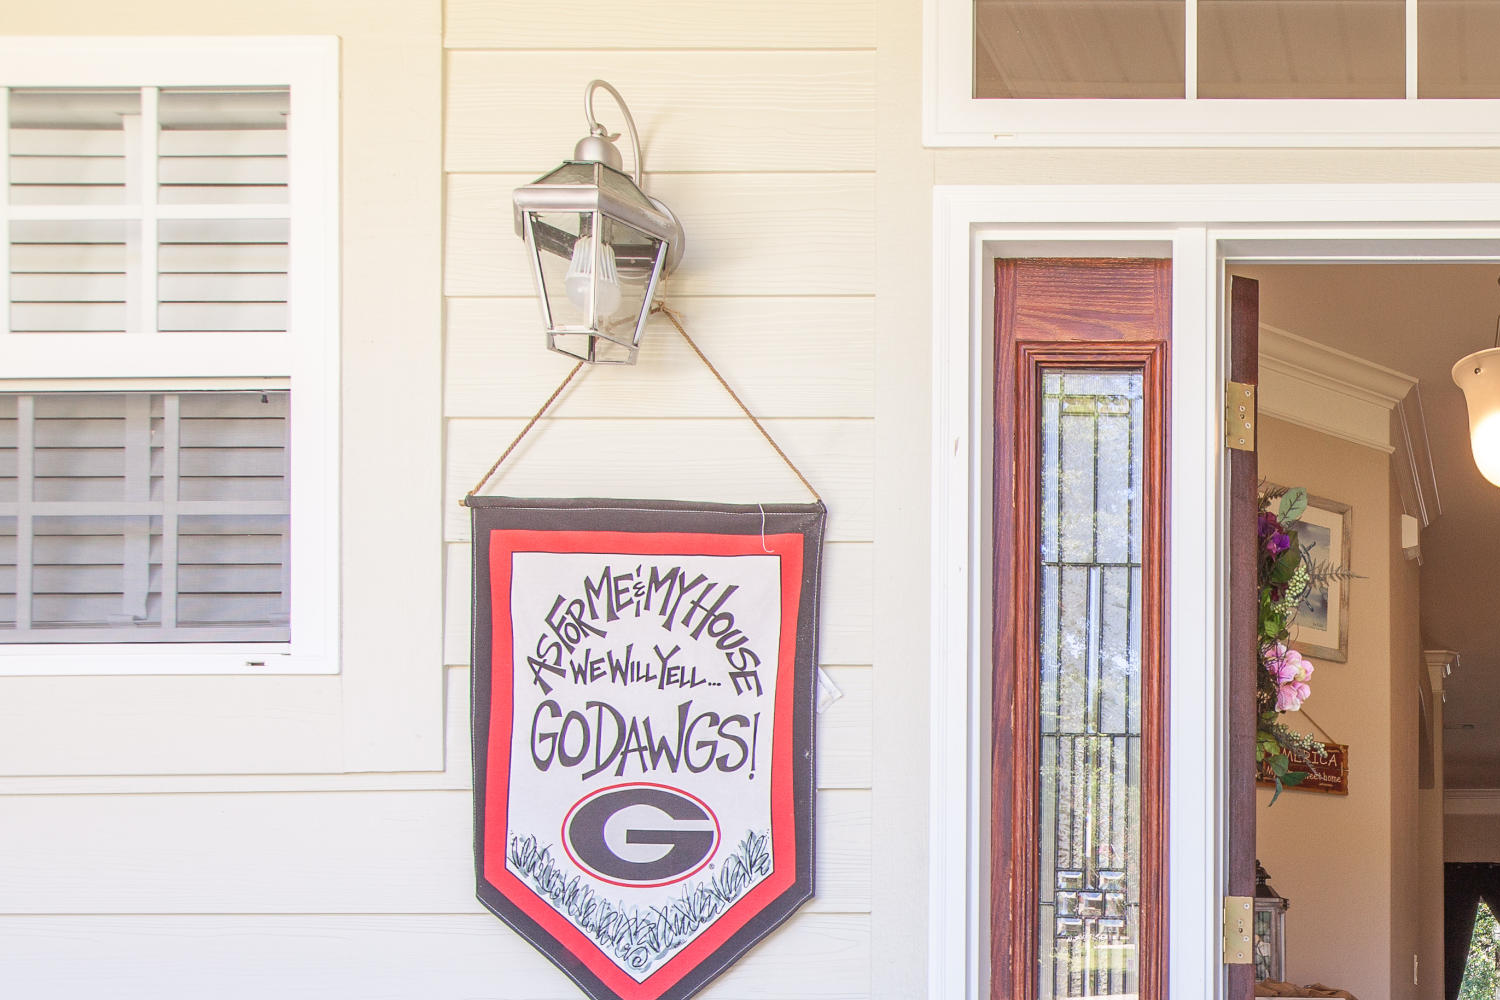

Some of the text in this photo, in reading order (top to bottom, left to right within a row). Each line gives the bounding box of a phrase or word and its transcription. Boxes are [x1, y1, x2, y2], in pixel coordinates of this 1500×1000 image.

[545, 594, 608, 655] FOR
[583, 565, 635, 623] ME
[643, 566, 709, 632] MY
[527, 633, 567, 696] AS
[569, 648, 607, 685] WE
[607, 643, 657, 687] WILL
[680, 582, 764, 696] HOUSE
[530, 699, 761, 781] GO DAWGS!
[1271, 746, 1337, 767] MERICA
[1323, 771, 1341, 783] home
[568, 788, 715, 881] G
